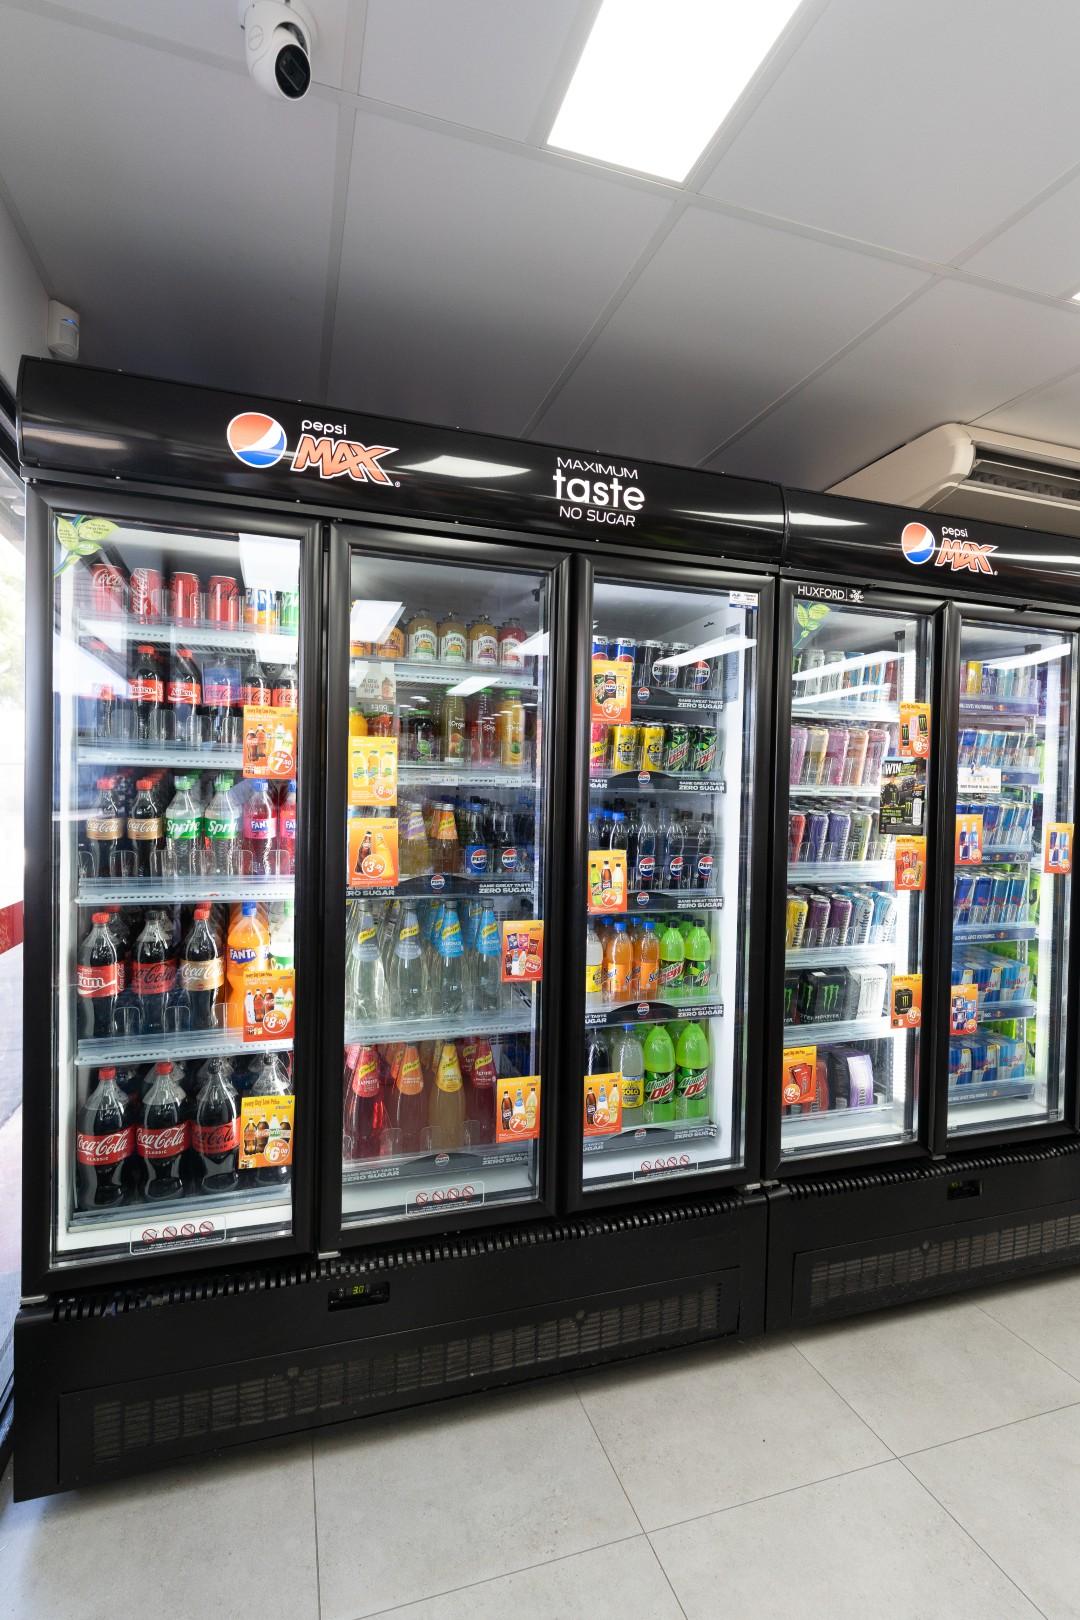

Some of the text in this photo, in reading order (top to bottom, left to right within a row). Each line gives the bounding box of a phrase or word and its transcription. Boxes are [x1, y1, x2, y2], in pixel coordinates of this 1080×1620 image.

[301, 419, 347, 436] pepsi
[290, 434, 399, 487] MAX
[557, 456, 639, 480] MAXIMUM
[552, 468, 645, 511] taste
[559, 505, 636, 527] NO SUGAR
[941, 526, 969, 538] pepsi
[934, 538, 999, 575] MAX
[797, 585, 845, 600] HUXFORD
[885, 762, 901, 775] WIN
[166, 819, 201, 834] Sprite
[229, 948, 258, 961] FANTA
[78, 1130, 128, 1155] Coca-Cola
[136, 1124, 185, 1149] Coca-Cola
[369, 1171, 399, 1179] SUGAR
